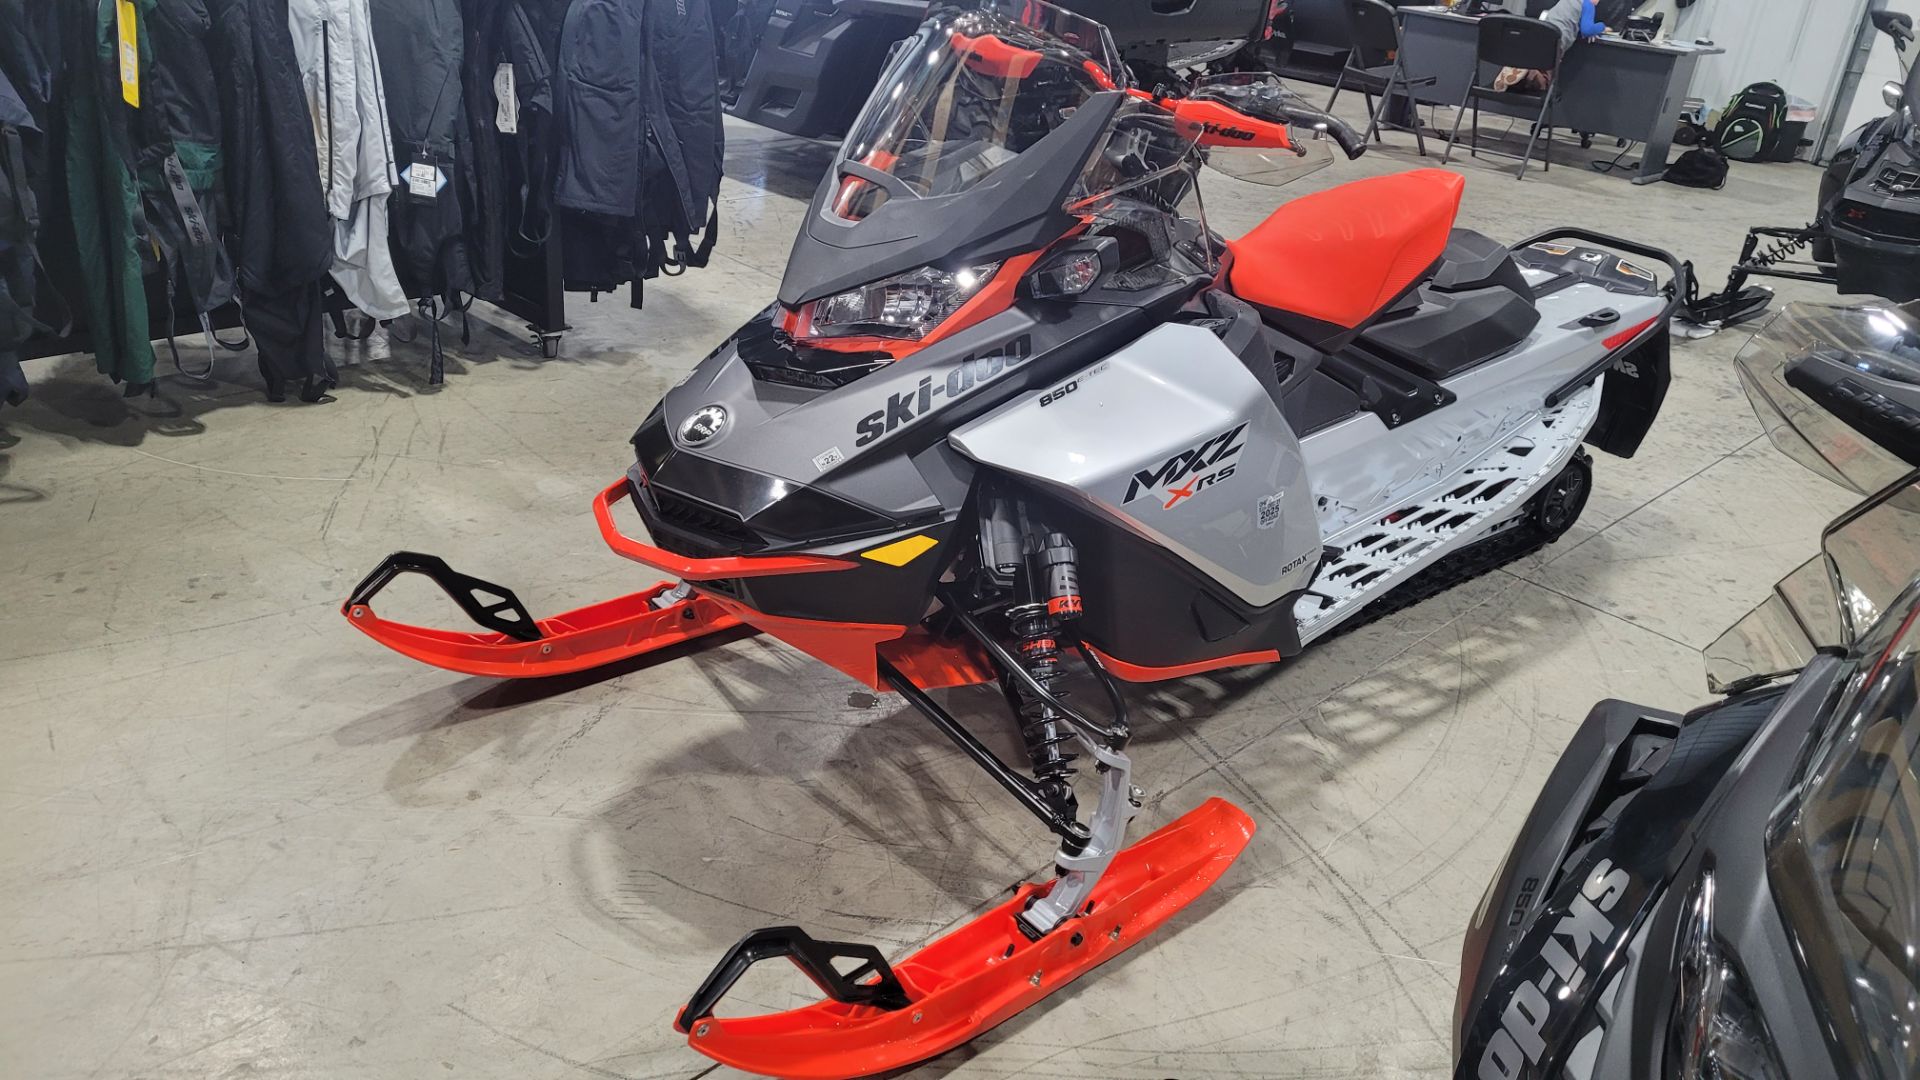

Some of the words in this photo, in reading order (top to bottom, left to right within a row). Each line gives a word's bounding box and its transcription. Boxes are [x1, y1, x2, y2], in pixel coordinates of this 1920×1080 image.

[855, 333, 1032, 448] ski-doo
[1039, 380, 1078, 408] 850
[692, 422, 713, 436] BRP
[1122, 421, 1249, 505] MXZ
[1260, 504, 1280, 520] 2025
[1281, 554, 1307, 576] ROTAX
[1058, 598, 1082, 608] KY
[1509, 876, 1539, 927] 850
[1478, 857, 1630, 1080] ski-do
